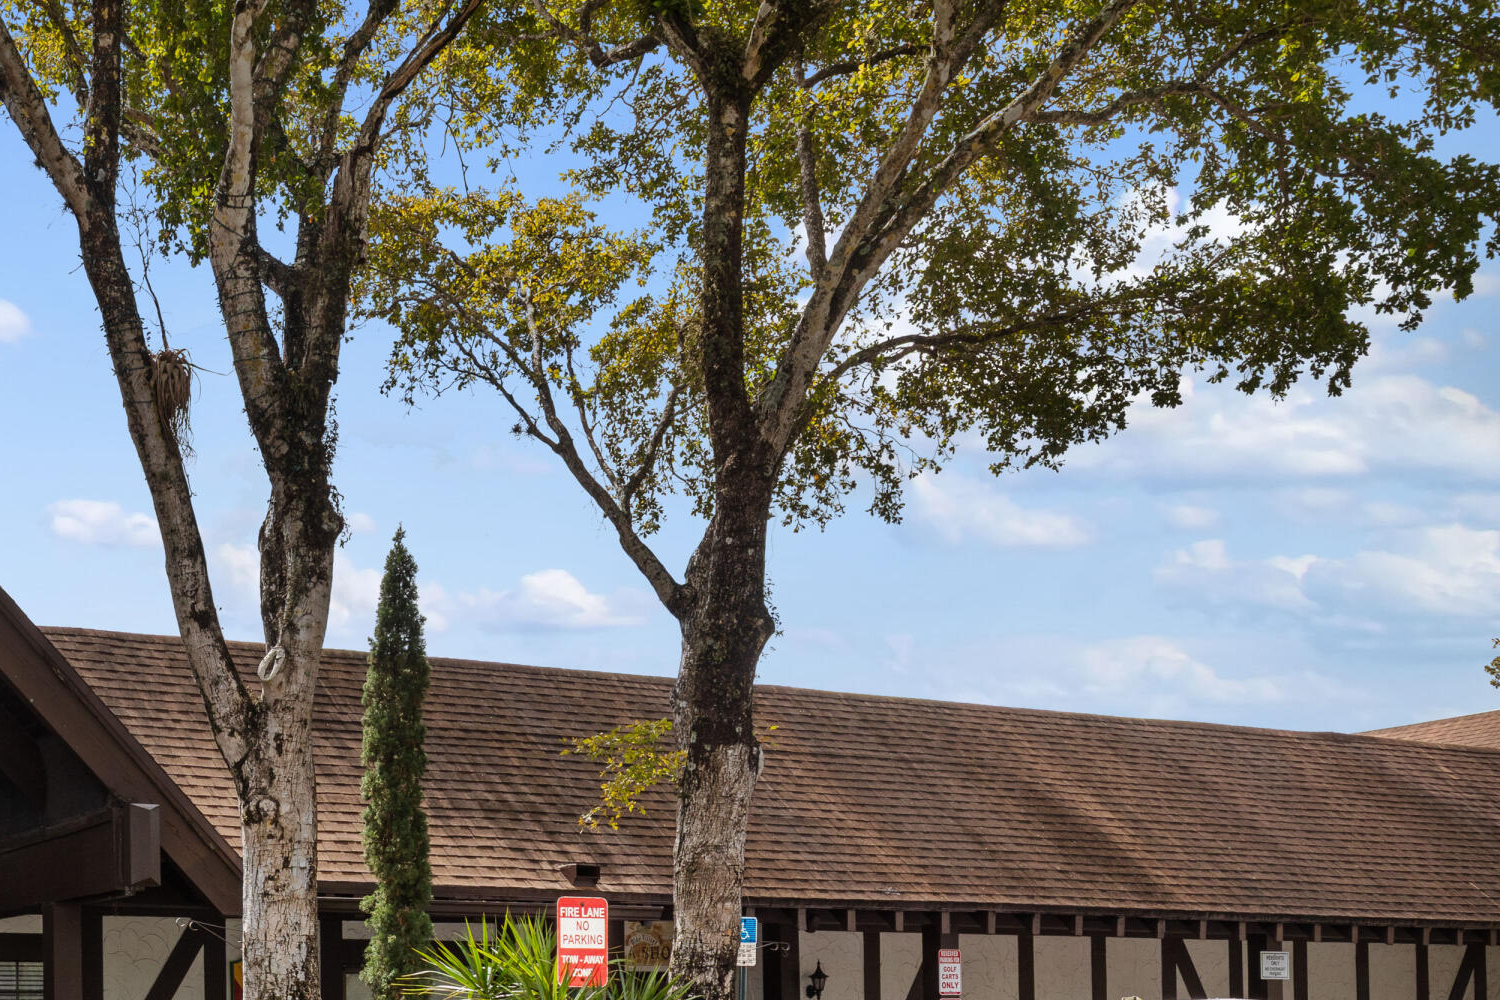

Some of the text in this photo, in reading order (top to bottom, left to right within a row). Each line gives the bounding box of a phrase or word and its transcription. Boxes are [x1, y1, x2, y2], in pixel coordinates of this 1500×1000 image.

[560, 907, 605, 918] FIRE LANE
[576, 920, 590, 931] NO
[563, 934, 603, 945] PARKING
[642, 946, 670, 960] SHO
[561, 955, 579, 964] TOW
[583, 955, 604, 965] AWAY
